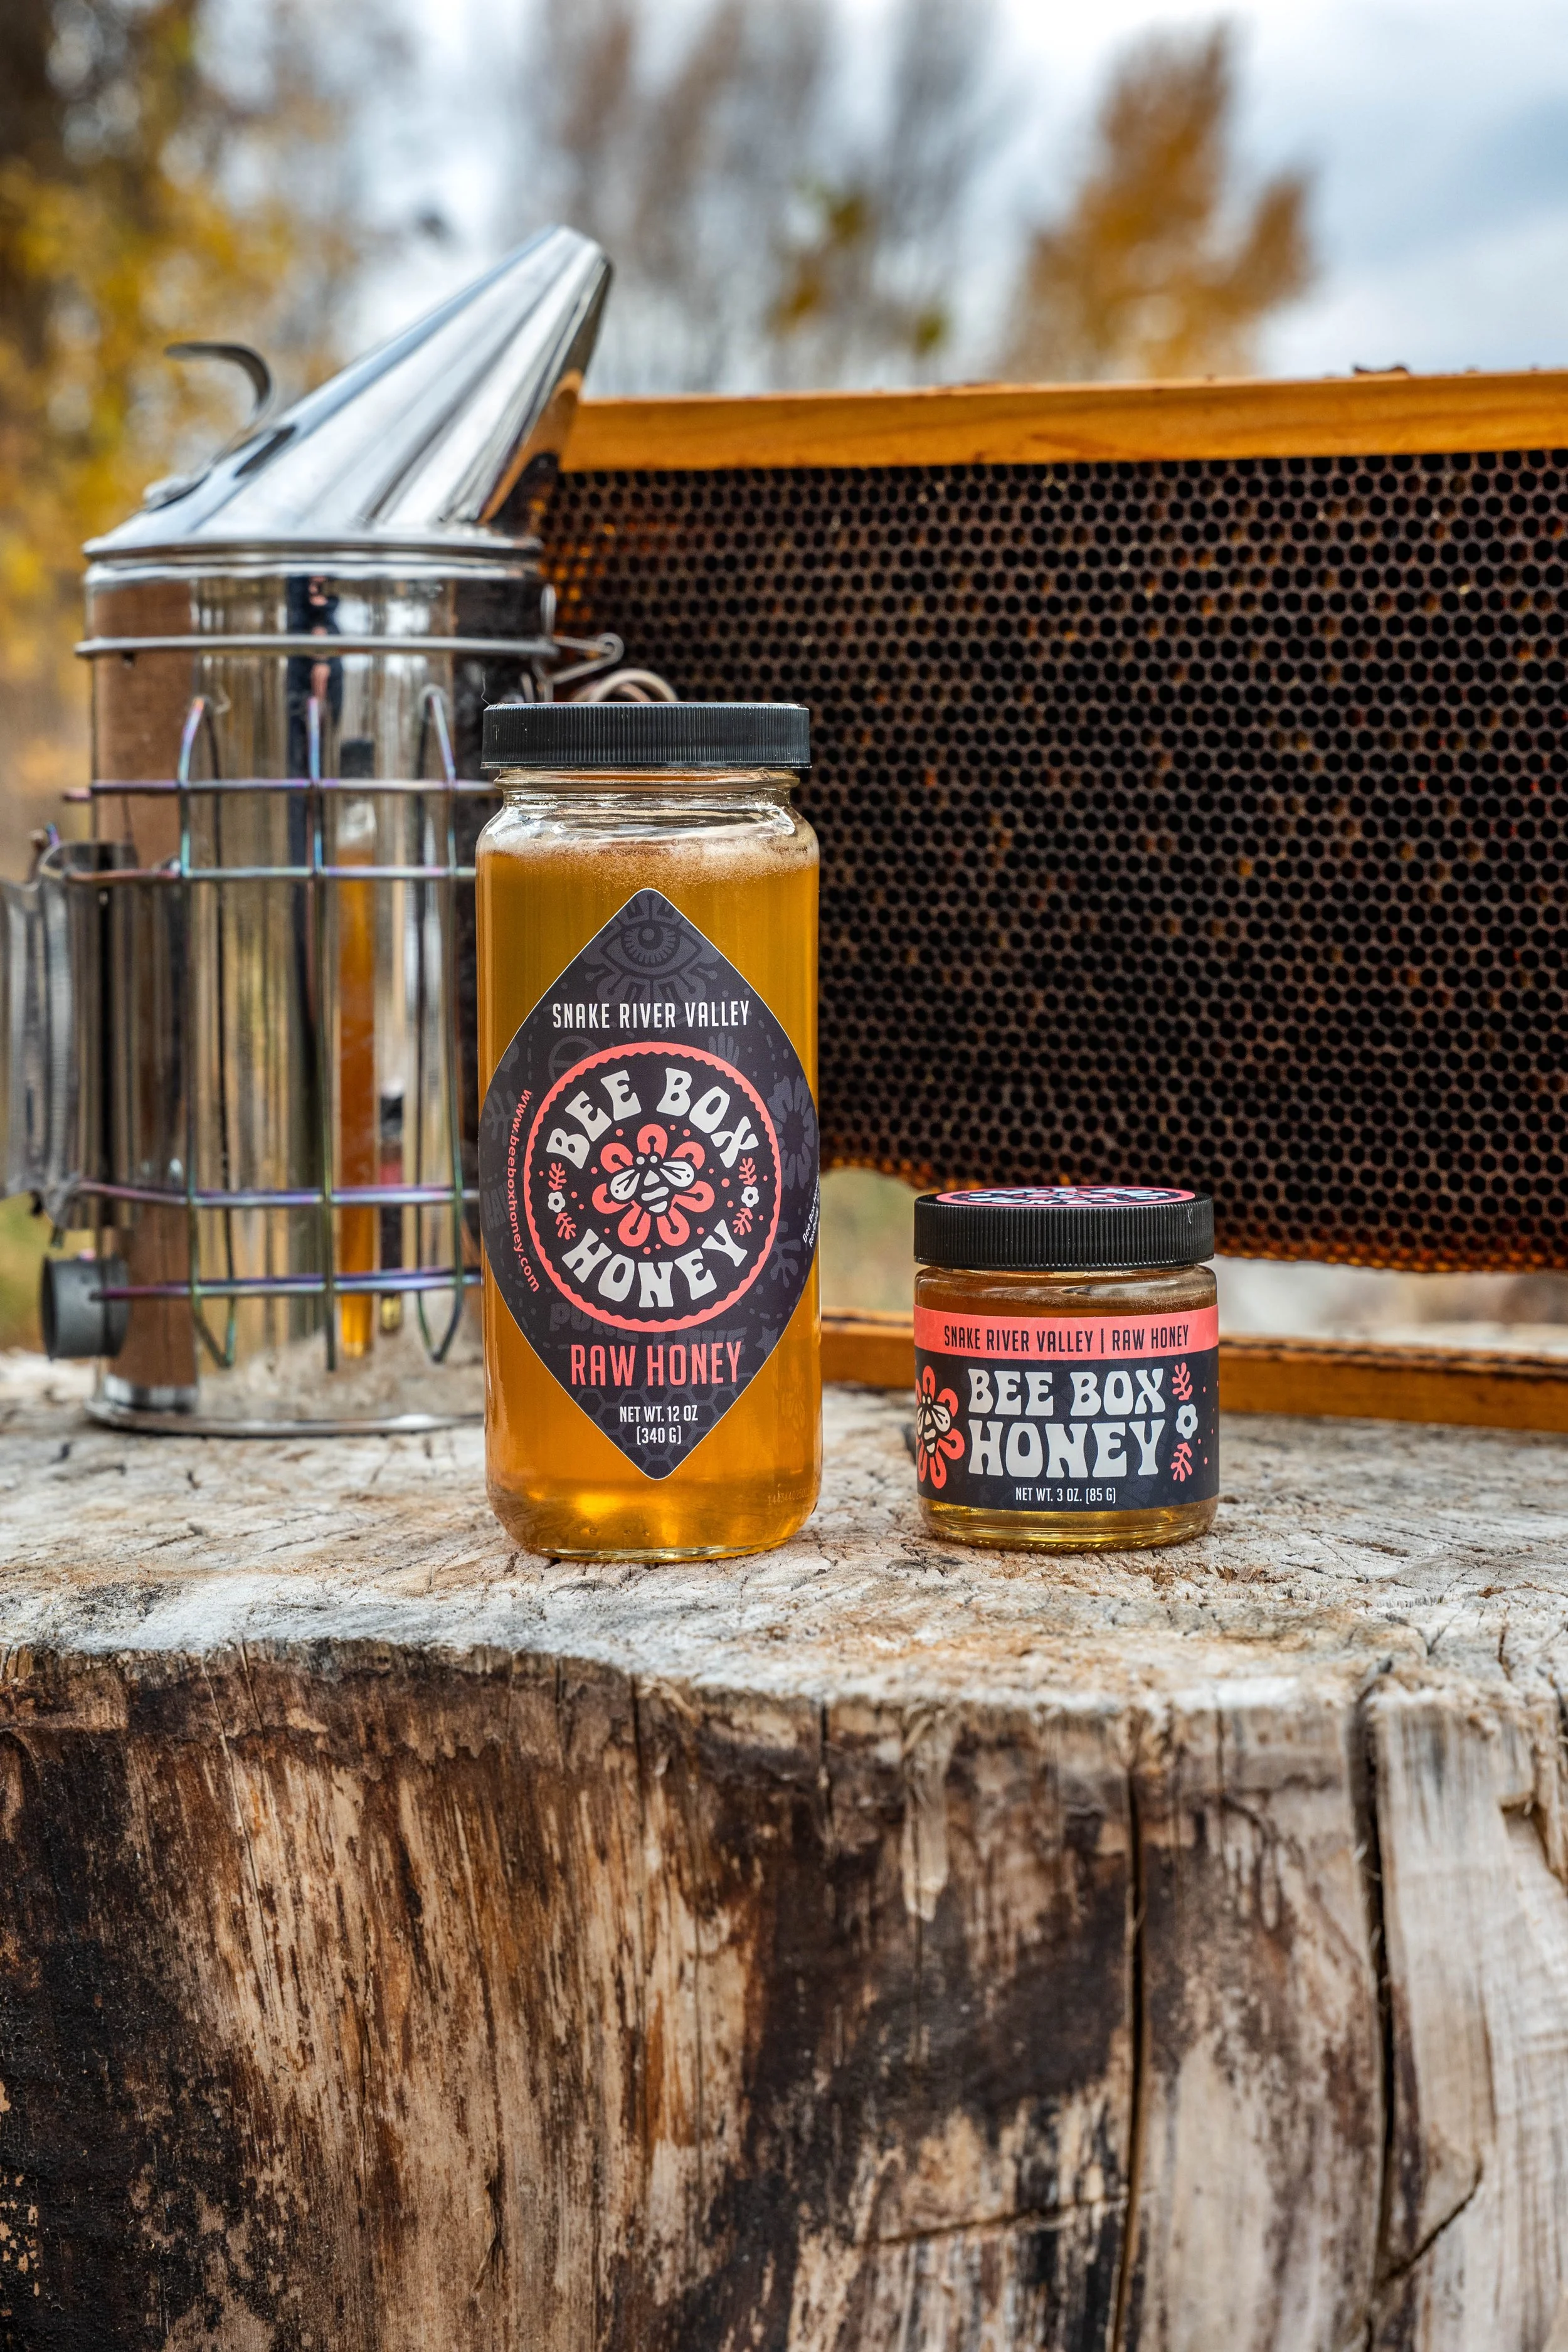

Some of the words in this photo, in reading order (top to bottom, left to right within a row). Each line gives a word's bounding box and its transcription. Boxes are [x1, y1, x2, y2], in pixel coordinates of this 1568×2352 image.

[553, 1003, 610, 1029] SNAKE
[619, 1002, 676, 1029] RIVER
[684, 1000, 750, 1028] VALLEY
[546, 1069, 642, 1169] BEE
[656, 1067, 760, 1168] BOX
[507, 1089, 540, 1293] www.beeboxhoney.com
[803, 1223, 811, 1243] Bee
[561, 1219, 748, 1308] HONEY
[944, 1325, 980, 1350] SNAKE
[987, 1329, 1029, 1352] RIVER
[1036, 1331, 1093, 1353] VALLEY
[1112, 1328, 1145, 1351] RAW
[1151, 1324, 1189, 1349] HONEY
[571, 1344, 636, 1386] RAW
[647, 1341, 741, 1386] HONEY
[620, 1406, 641, 1422] NET
[643, 1406, 665, 1422] WT.
[667, 1405, 680, 1422] 12
[683, 1404, 699, 1422] OZ
[968, 1368, 1054, 1416] BEE
[1069, 1368, 1166, 1416] BOX
[968, 1419, 1165, 1478] HONEY
[1015, 1486, 1033, 1501] NET
[1036, 1487, 1054, 1502] WT.
[1056, 1488, 1064, 1502] 3
[1066, 1488, 1083, 1502] OZ.
